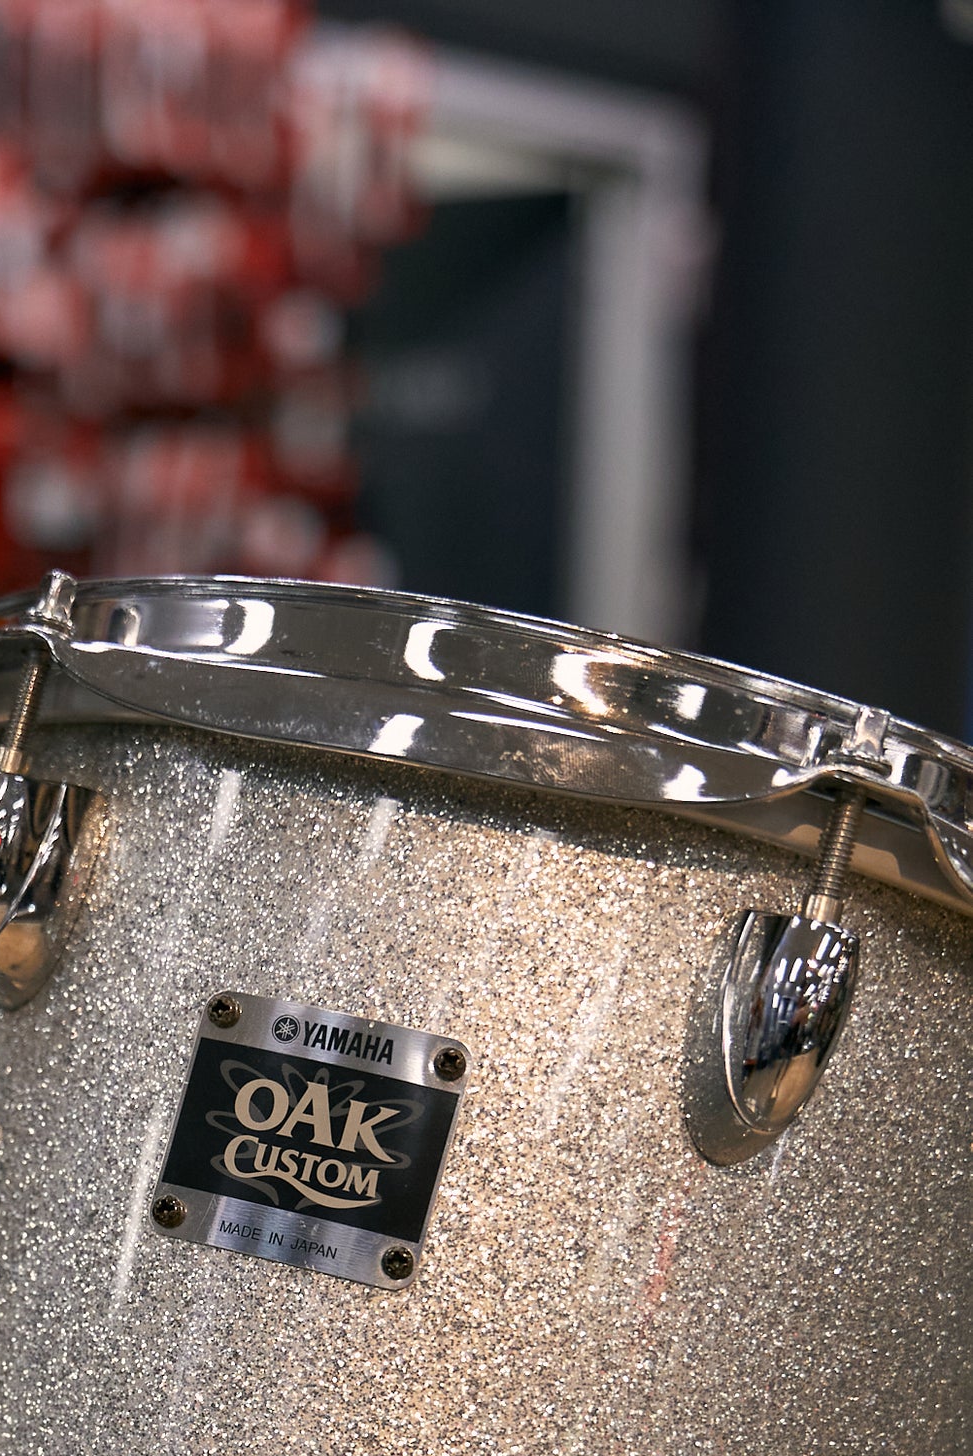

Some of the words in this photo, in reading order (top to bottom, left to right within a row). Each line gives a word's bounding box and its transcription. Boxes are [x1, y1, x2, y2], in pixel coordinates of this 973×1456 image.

[303, 1021, 394, 1065] YAMAHA
[234, 1079, 400, 1163] OAK
[224, 1135, 382, 1209] CUSTOM
[220, 1220, 260, 1241] MADE
[269, 1232, 284, 1246] IN
[290, 1237, 338, 1259] JAPAN
